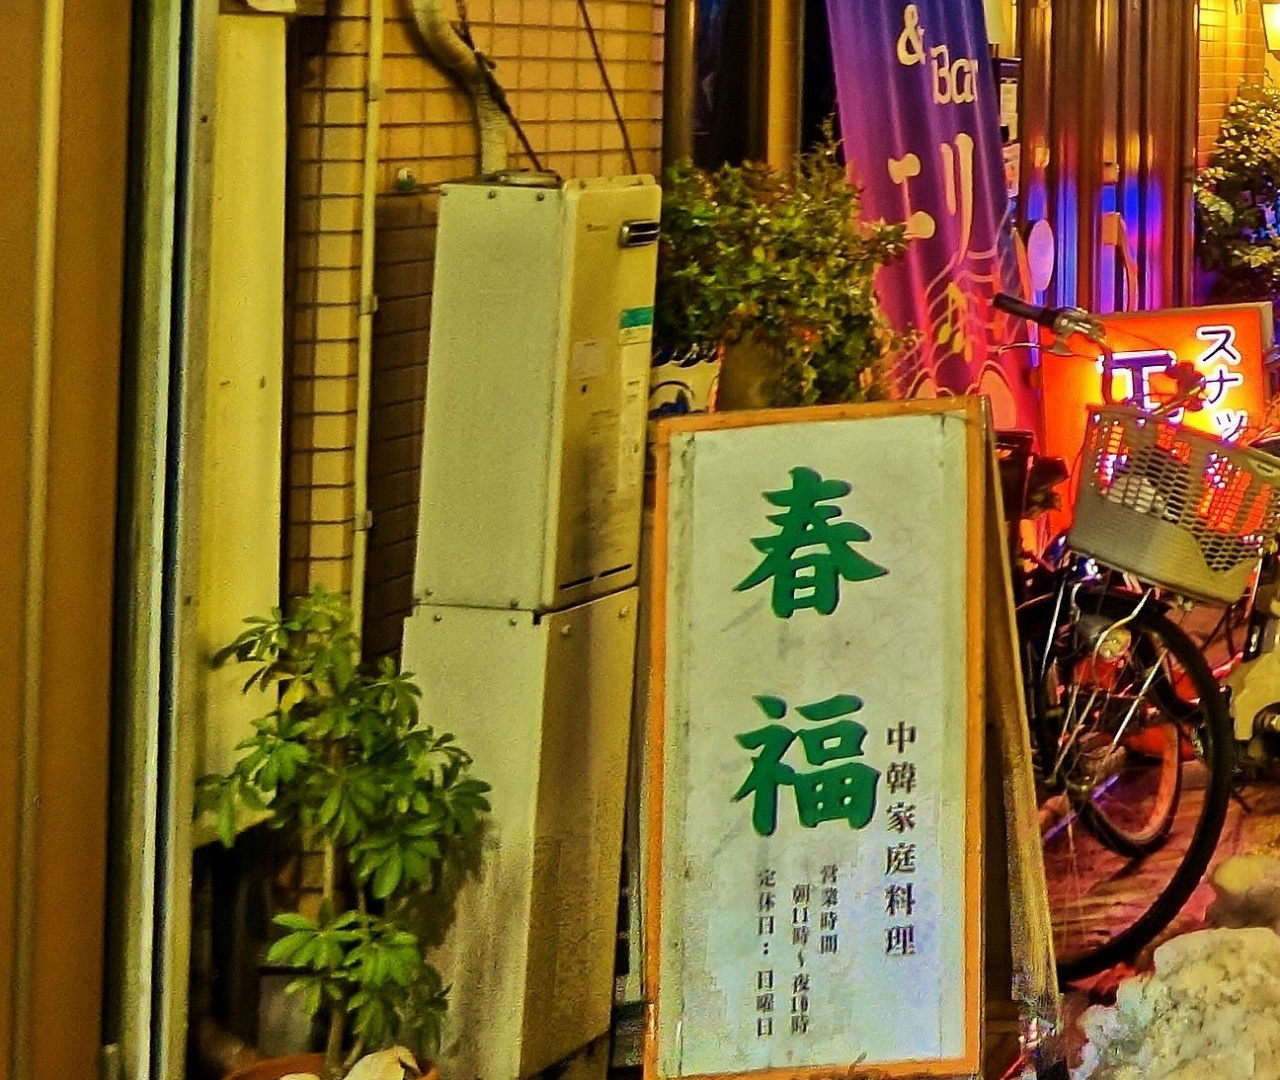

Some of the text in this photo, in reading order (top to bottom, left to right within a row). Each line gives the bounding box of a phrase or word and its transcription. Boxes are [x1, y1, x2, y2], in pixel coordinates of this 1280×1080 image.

[896, 3, 926, 66] &
[930, 43, 979, 105] Bar
[1196, 324, 1248, 444] スナッ
[731, 465, 892, 839] 春福
[884, 720, 919, 956] 中韓家庭料理
